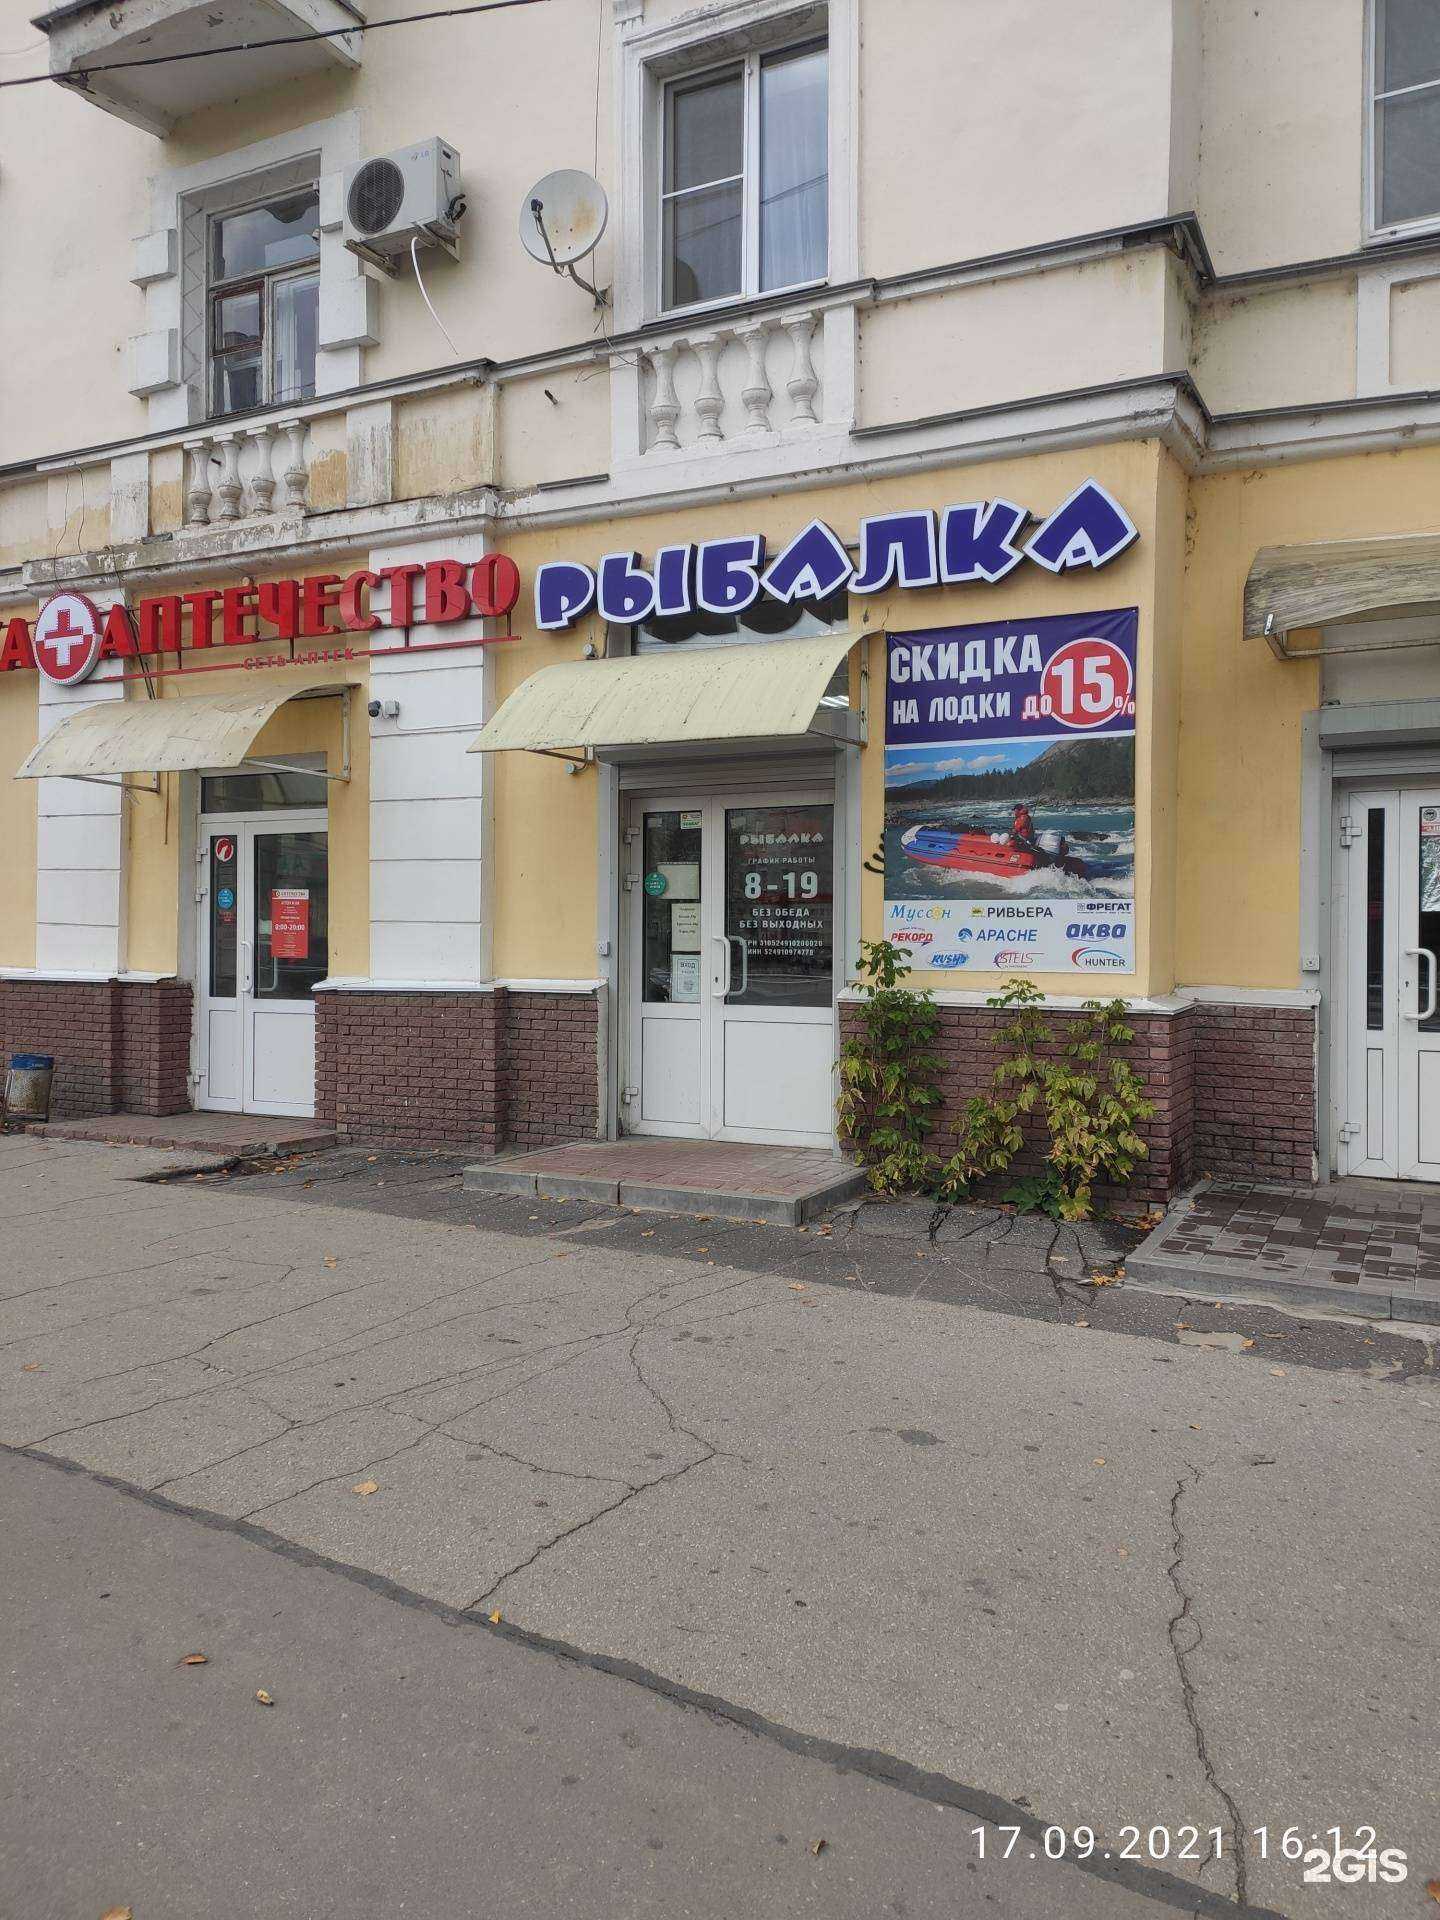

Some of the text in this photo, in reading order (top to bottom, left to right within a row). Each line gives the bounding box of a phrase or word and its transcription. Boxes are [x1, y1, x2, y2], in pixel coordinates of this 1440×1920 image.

[534, 476, 1140, 631] РЫБАЛКА
[99, 553, 520, 658] АПТЕЧЕСТВО
[243, 648, 354, 671] СЕТЬ АПТЕК
[890, 634, 1043, 684] СКИДКА
[892, 692, 1011, 724] НА ЛОДКИ
[747, 857, 816, 865] ГРАФИК РАБОТЫ
[752, 908, 810, 917] БЕЗ ОБЕДА
[987, 906, 1053, 918] РИВЬЕРА
[1087, 902, 1132, 911] ФРЕГАТ
[739, 920, 824, 929] БЕЗ ВЫХОДНЫХ
[890, 932, 934, 943] РЕКОРД
[976, 929, 1038, 942] APACHE
[1085, 957, 1126, 967] HUNTER
